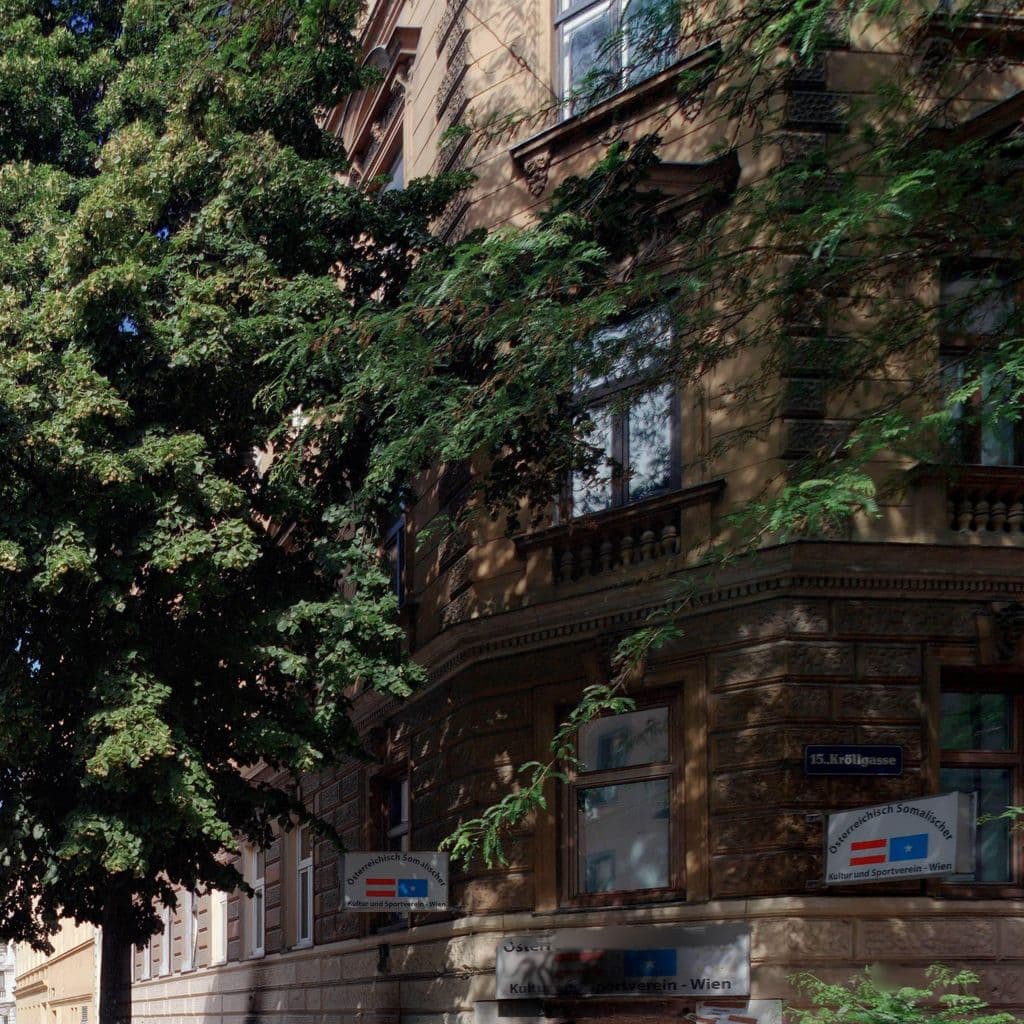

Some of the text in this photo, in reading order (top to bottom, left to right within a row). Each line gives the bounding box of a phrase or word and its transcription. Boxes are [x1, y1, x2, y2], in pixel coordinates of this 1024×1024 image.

[829, 803, 954, 855] Österreichisch Somalischer
[347, 854, 446, 887] Österreichisch Somalischer
[828, 870, 853, 881] Kultur
[853, 868, 870, 880] und
[871, 865, 922, 878] Sportverein
[929, 862, 952, 872] Wien
[690, 978, 732, 990] Wien
